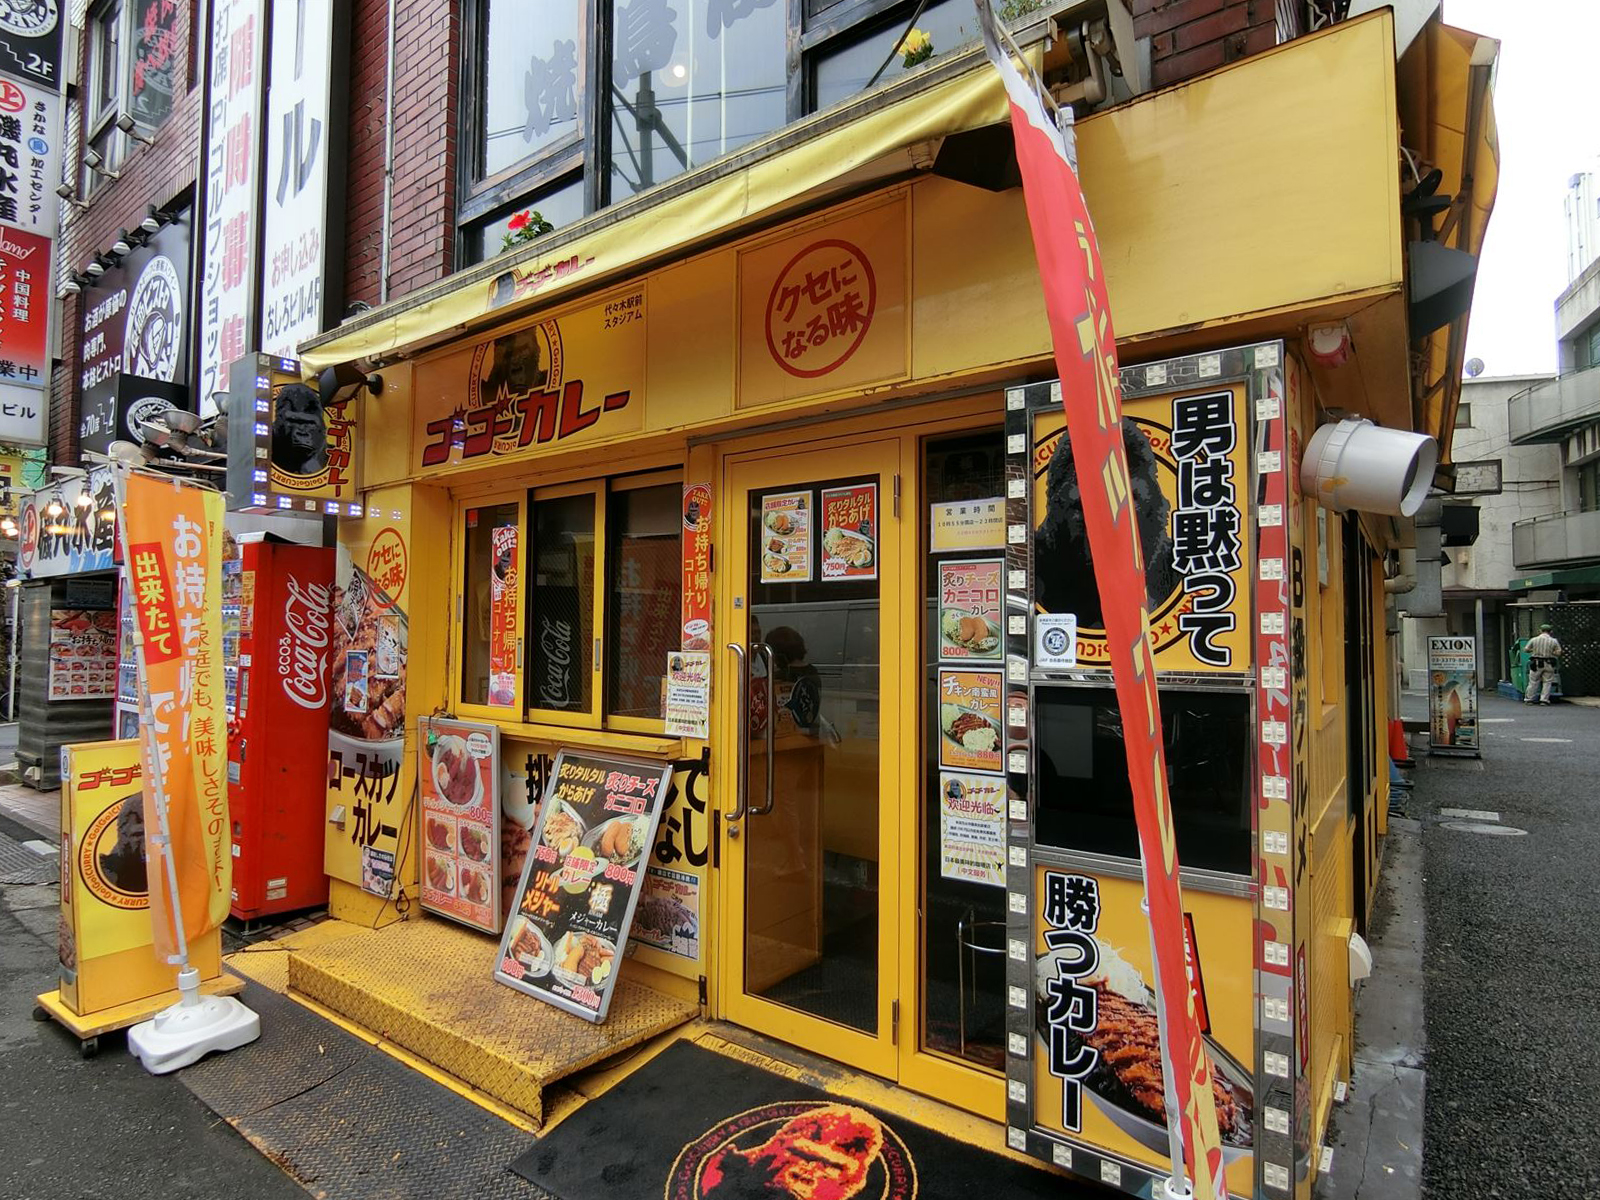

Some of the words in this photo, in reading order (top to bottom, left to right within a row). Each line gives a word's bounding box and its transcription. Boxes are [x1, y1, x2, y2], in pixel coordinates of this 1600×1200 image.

[27, 52, 53, 75] 2F
[13, 269, 31, 323] 中国料理
[776, 258, 858, 324] クセに
[604, 293, 644, 317] 代々木駅前
[604, 310, 644, 331] スタジアム
[781, 291, 870, 360] なる味
[421, 379, 633, 468] ゴーゴーカレー
[828, 504, 871, 529] からあげ
[945, 504, 996, 516] 営業時間
[1171, 390, 1242, 667] 男は黙って
[371, 542, 402, 572] クセに
[694, 514, 710, 609] お持ち帰り
[684, 559, 695, 618] コーナー
[943, 571, 1000, 587] 炙りチーズ
[135, 551, 173, 655] 出来たて
[943, 588, 1000, 604] カニコロ
[503, 565, 518, 673] お持ち帰り
[971, 604, 1000, 616] カレー
[492, 601, 504, 655] コーナー
[282, 573, 331, 710] Coca-Cola
[942, 646, 969, 657] 800円
[1431, 639, 1473, 651] EXION
[539, 614, 573, 709] Coca-Cola
[942, 675, 998, 698] チキン南蛮風
[976, 674, 1001, 687] NEW!!
[970, 698, 1000, 711] カレー
[558, 762, 607, 786] 炙りタルタル
[604, 770, 661, 799] 炙りチーズ
[557, 782, 598, 805] からあげ
[602, 792, 649, 816] カニコロ
[351, 798, 398, 848] カレー
[563, 854, 599, 875] 店舗限定
[603, 863, 638, 887] 800円
[534, 868, 561, 895] リトル
[561, 868, 593, 886] カレー
[521, 888, 562, 918] メジャー
[568, 910, 619, 933] メジャーカレー
[1043, 871, 1101, 1133] 勝つカレー
